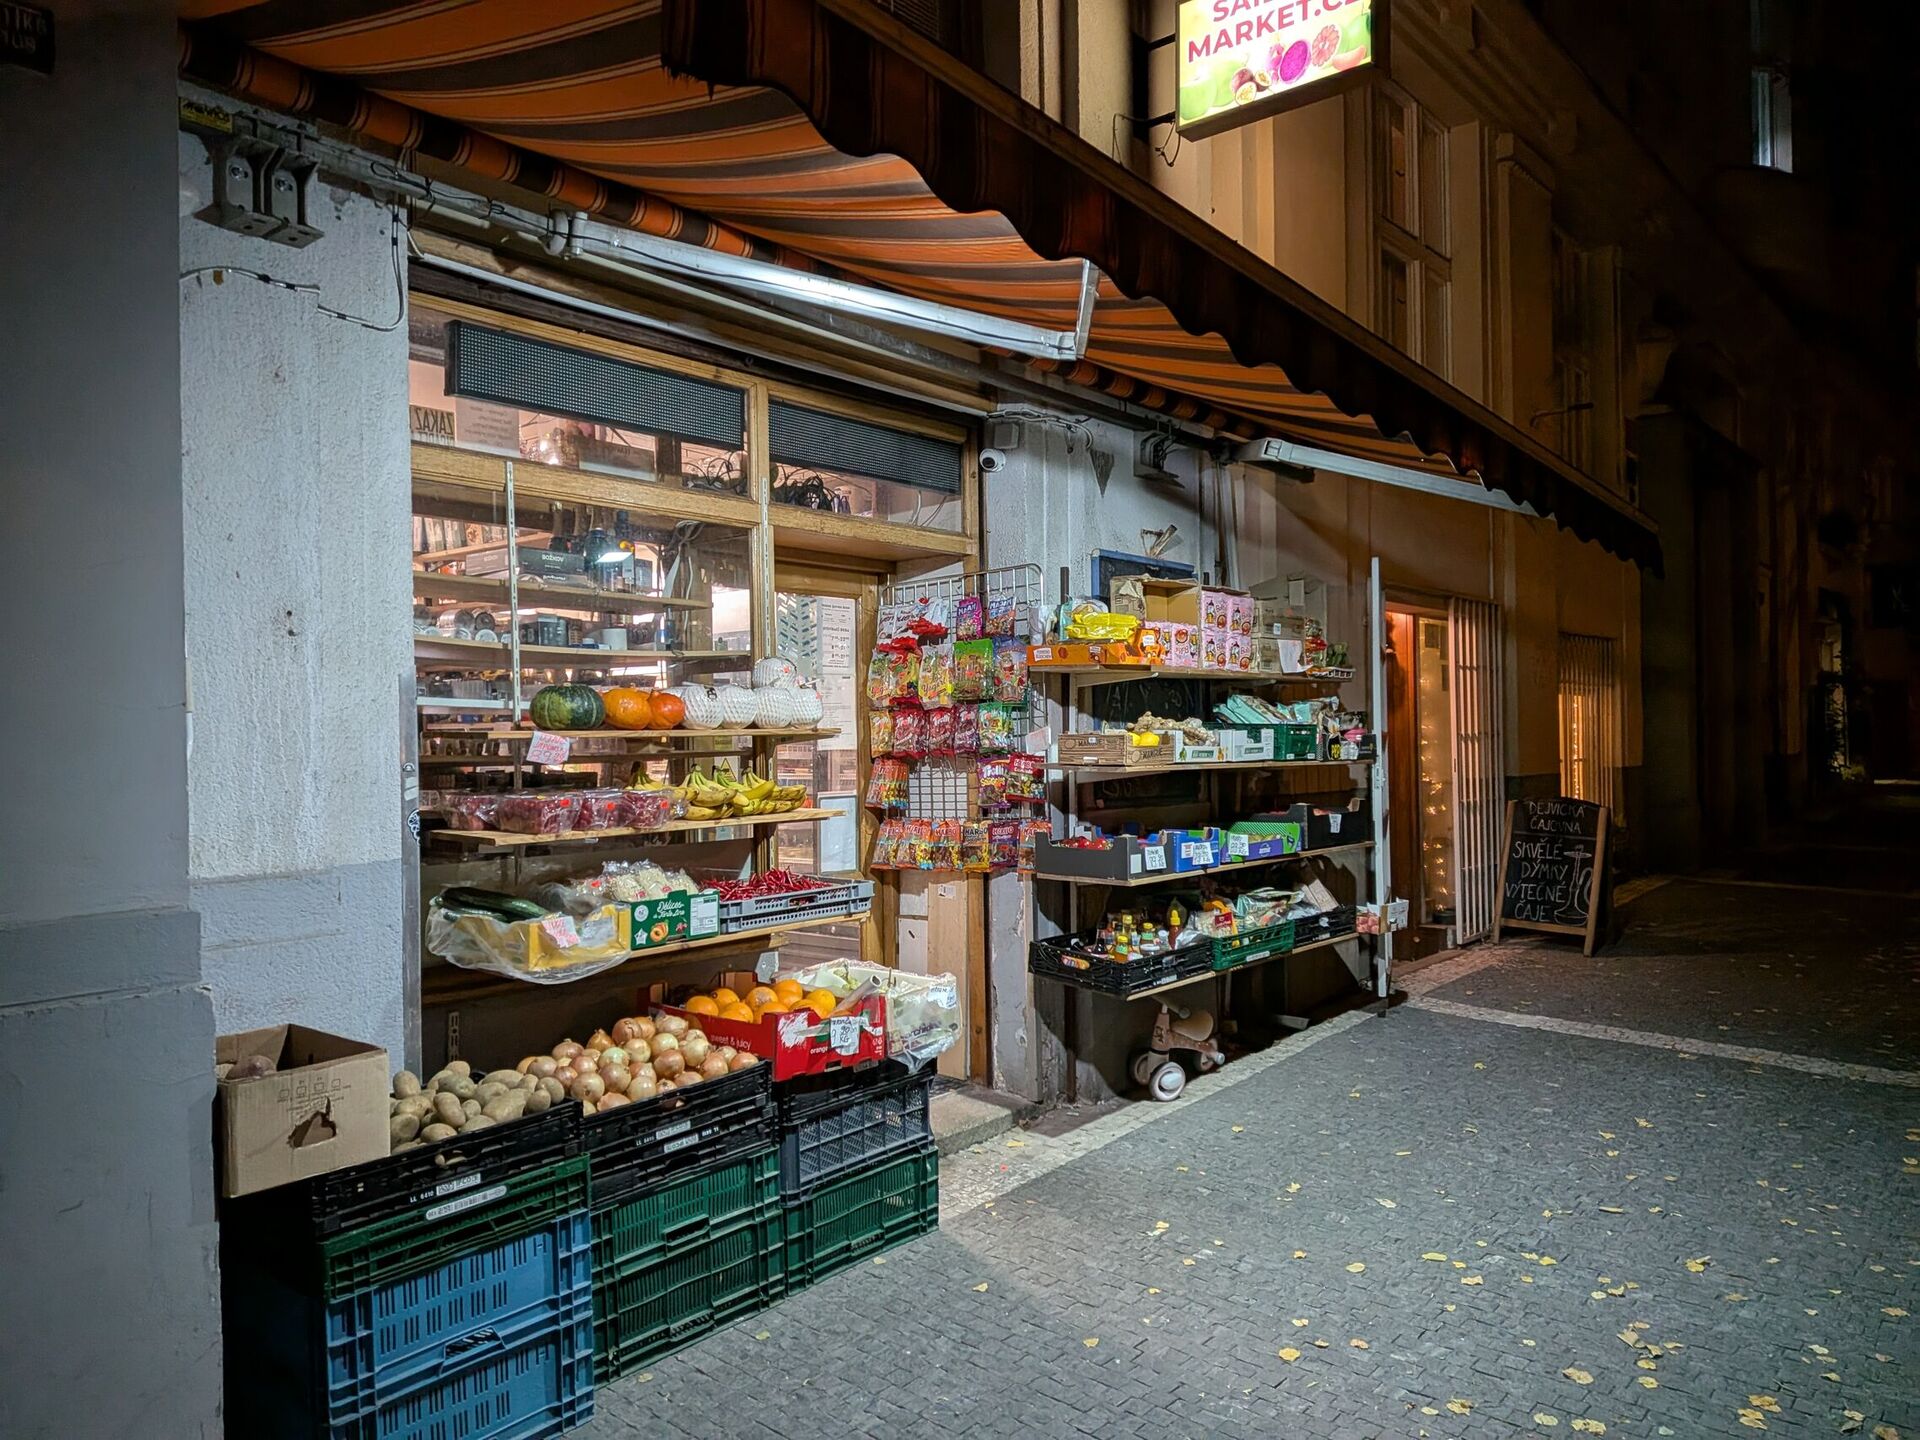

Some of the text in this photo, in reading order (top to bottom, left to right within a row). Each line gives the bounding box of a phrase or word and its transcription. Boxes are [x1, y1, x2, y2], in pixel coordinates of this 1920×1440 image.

[1512, 837, 1563, 860] SKVĚLÉ
[1521, 858, 1569, 880] DÝMKY
[1505, 878, 1567, 903] VÝTEČNÉ
[1514, 899, 1551, 922] ČAJE
[736, 1039, 751, 1051] juicy
[840, 1034, 850, 1043] KG
[410, 1195, 417, 1203] LL
